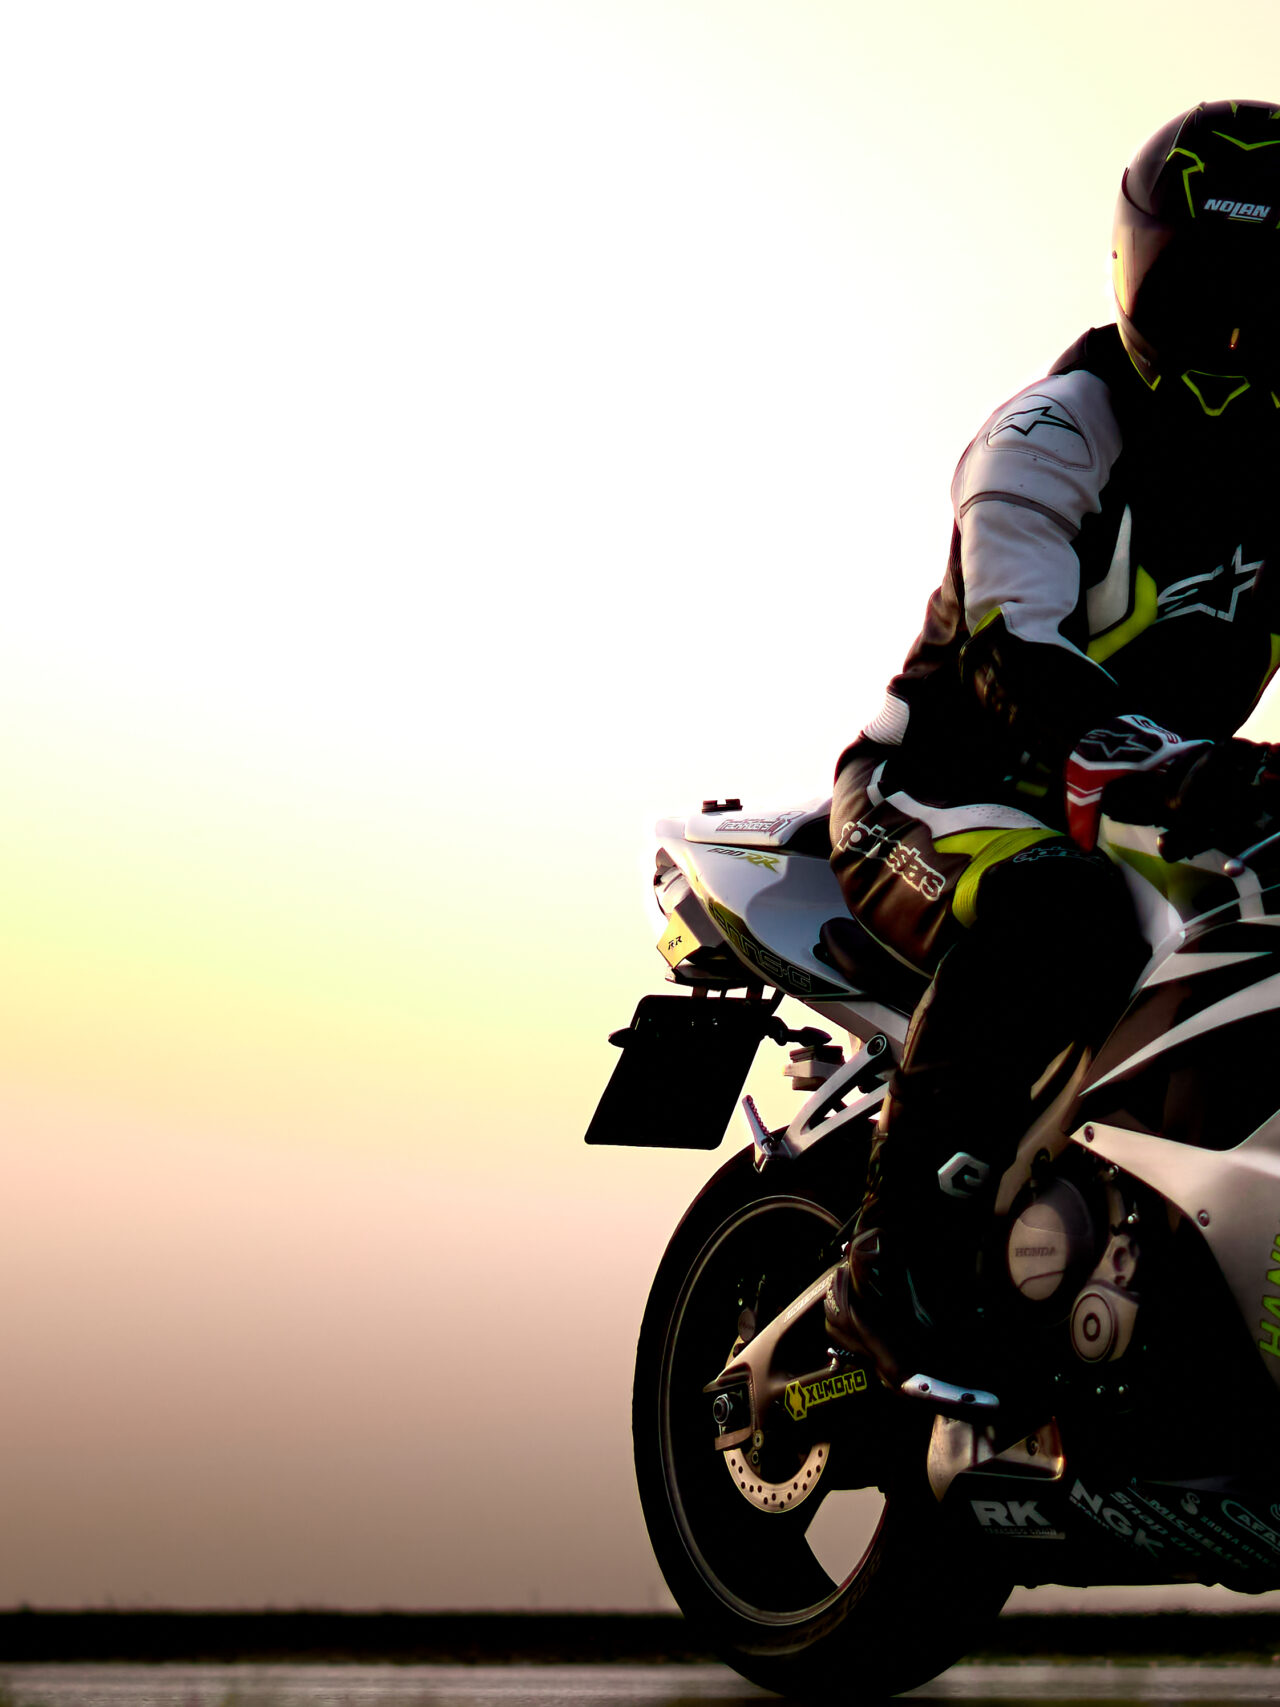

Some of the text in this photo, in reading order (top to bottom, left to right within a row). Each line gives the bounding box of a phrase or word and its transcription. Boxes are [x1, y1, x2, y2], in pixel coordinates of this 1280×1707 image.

[1203, 198, 1271, 221] NOLAN
[1015, 1246, 1056, 1258] HONDA
[806, 1370, 866, 1404] XLMOTO
[970, 1499, 1053, 1526] RK
[1070, 1478, 1165, 1559] NGK
